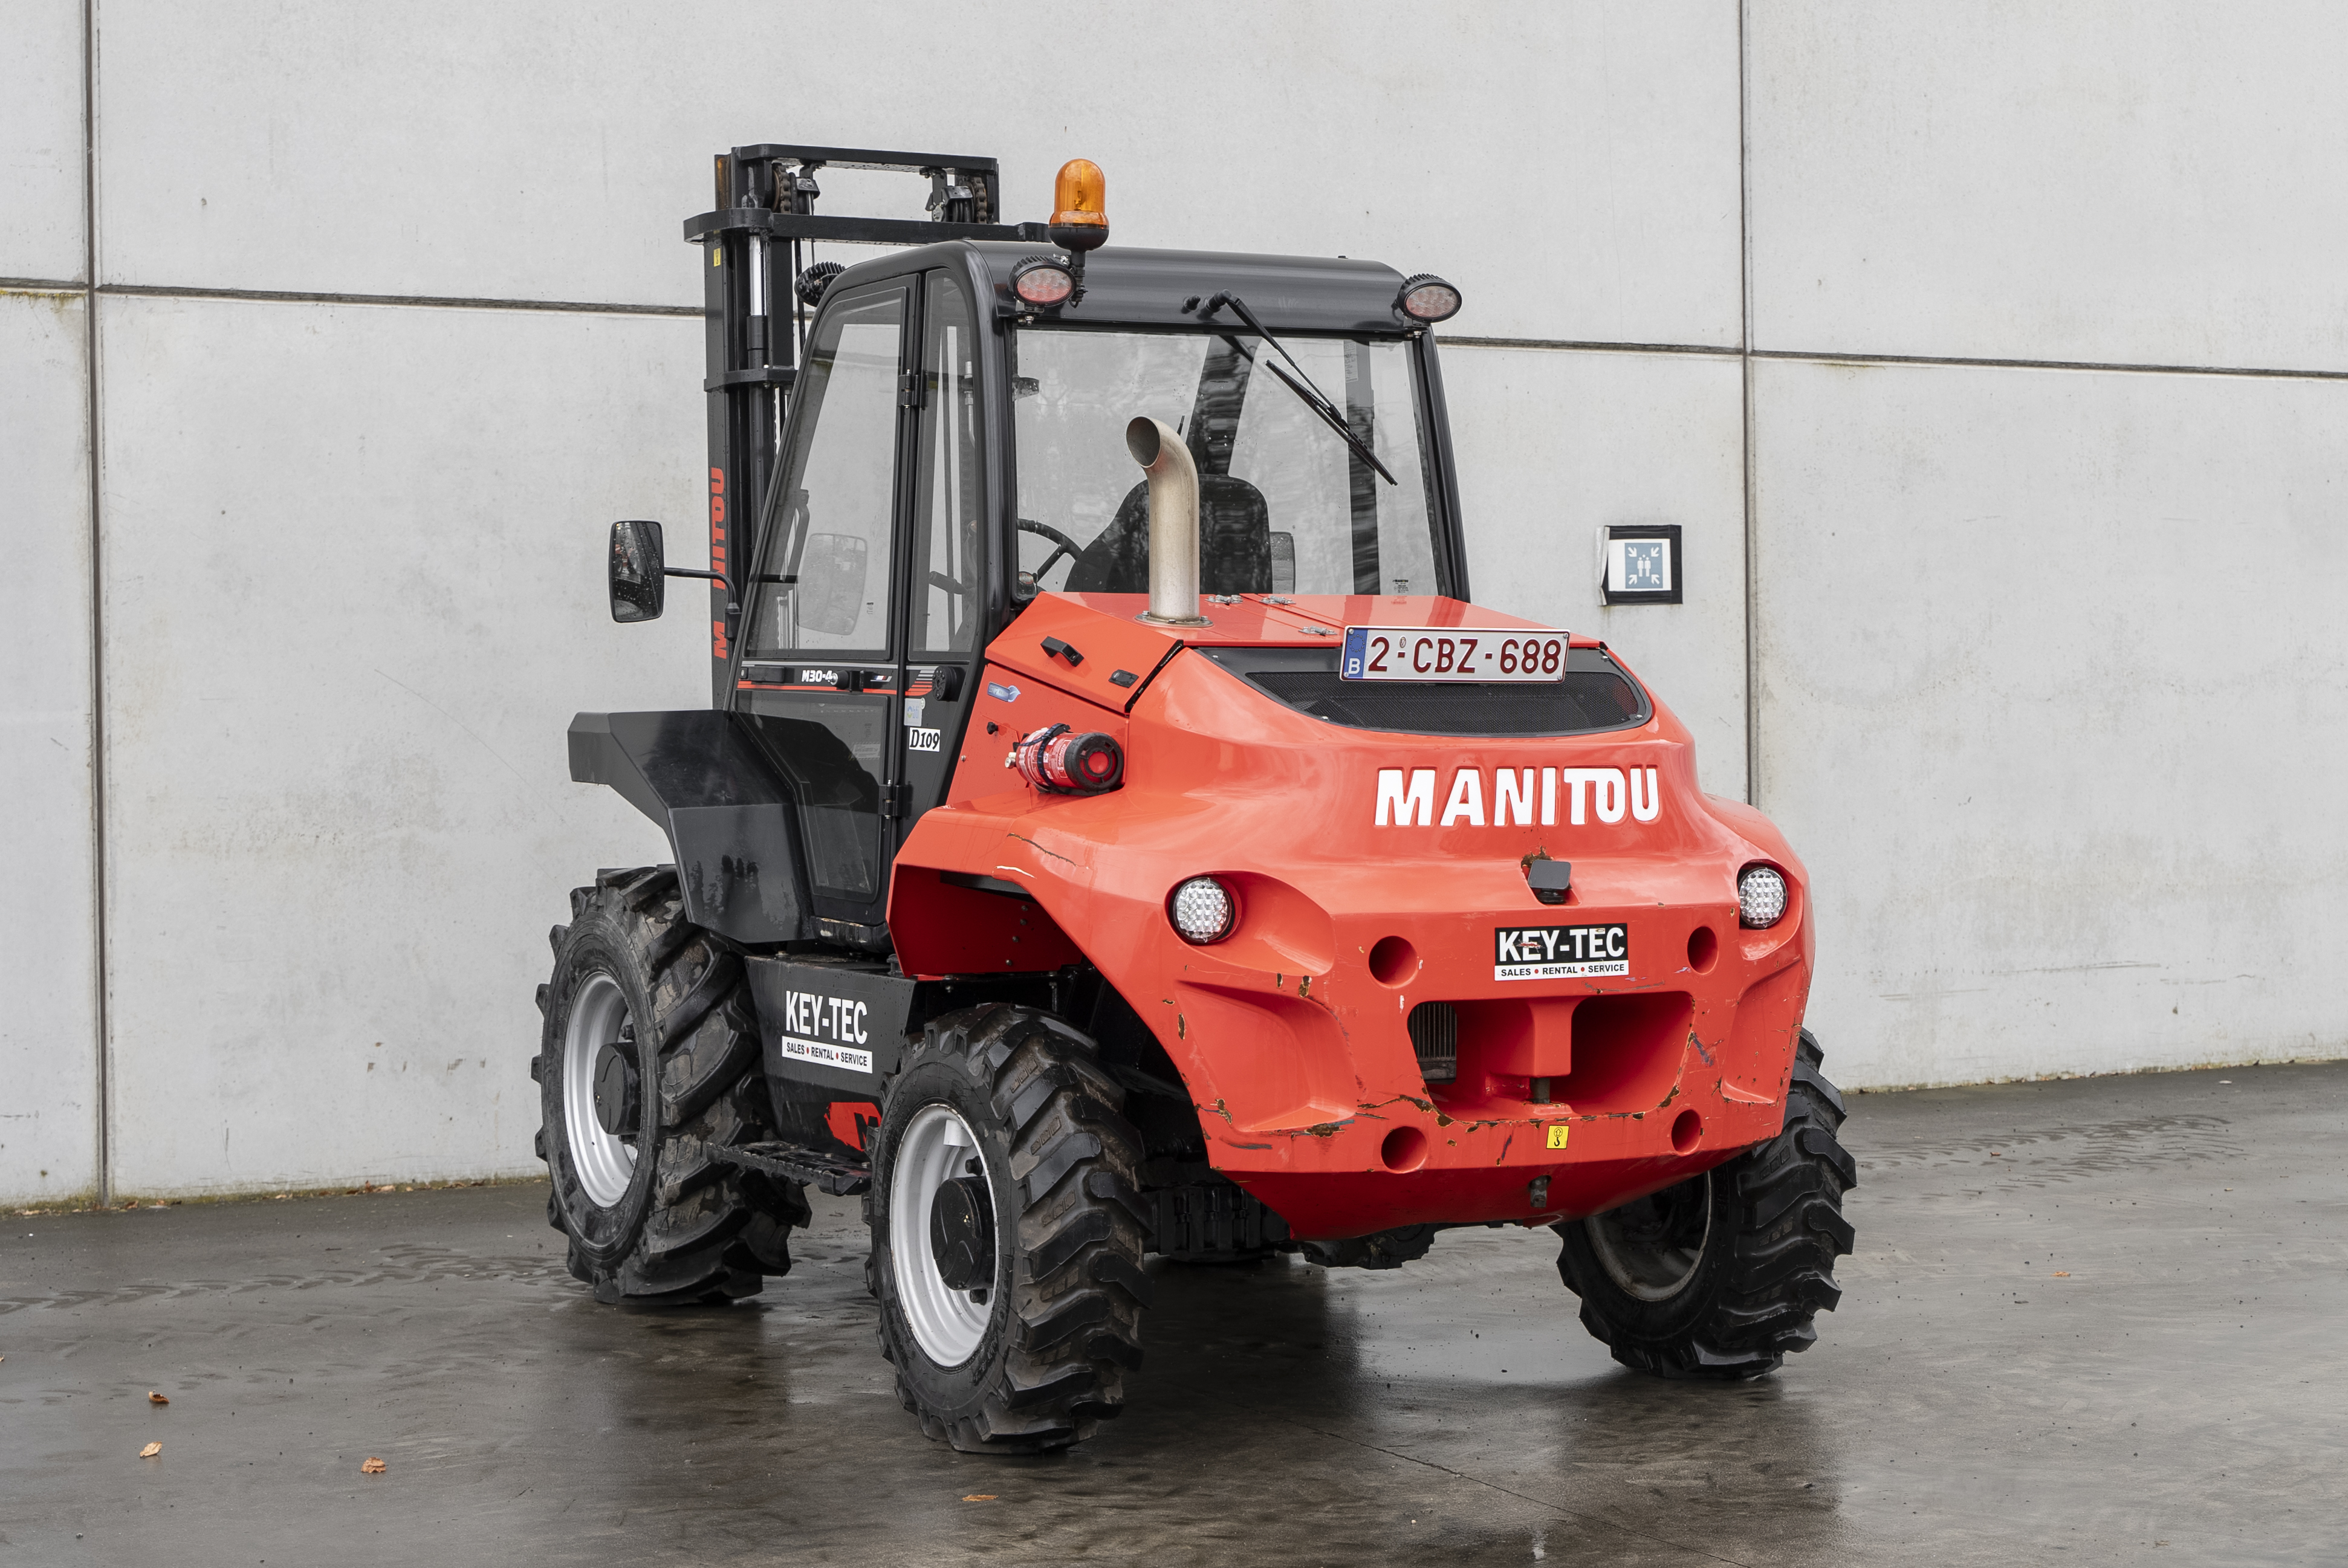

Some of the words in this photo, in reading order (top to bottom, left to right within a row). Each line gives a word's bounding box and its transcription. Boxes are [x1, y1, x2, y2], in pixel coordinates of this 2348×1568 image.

[711, 467, 727, 659] MNITOU
[1348, 658, 1360, 675] B
[910, 729, 940, 750] D109
[1375, 767, 1660, 826] MANITOU
[1499, 927, 1624, 962] KEY-TEC
[1501, 968, 1531, 977] SALES
[1542, 967, 1578, 975] RENTAL
[1588, 964, 1624, 973] SERVICE
[786, 990, 868, 1045] KEY-TEC
[786, 1042, 805, 1055] SALES
[811, 1046, 834, 1061] RENTAL
[840, 1052, 868, 1066] SERVICE
